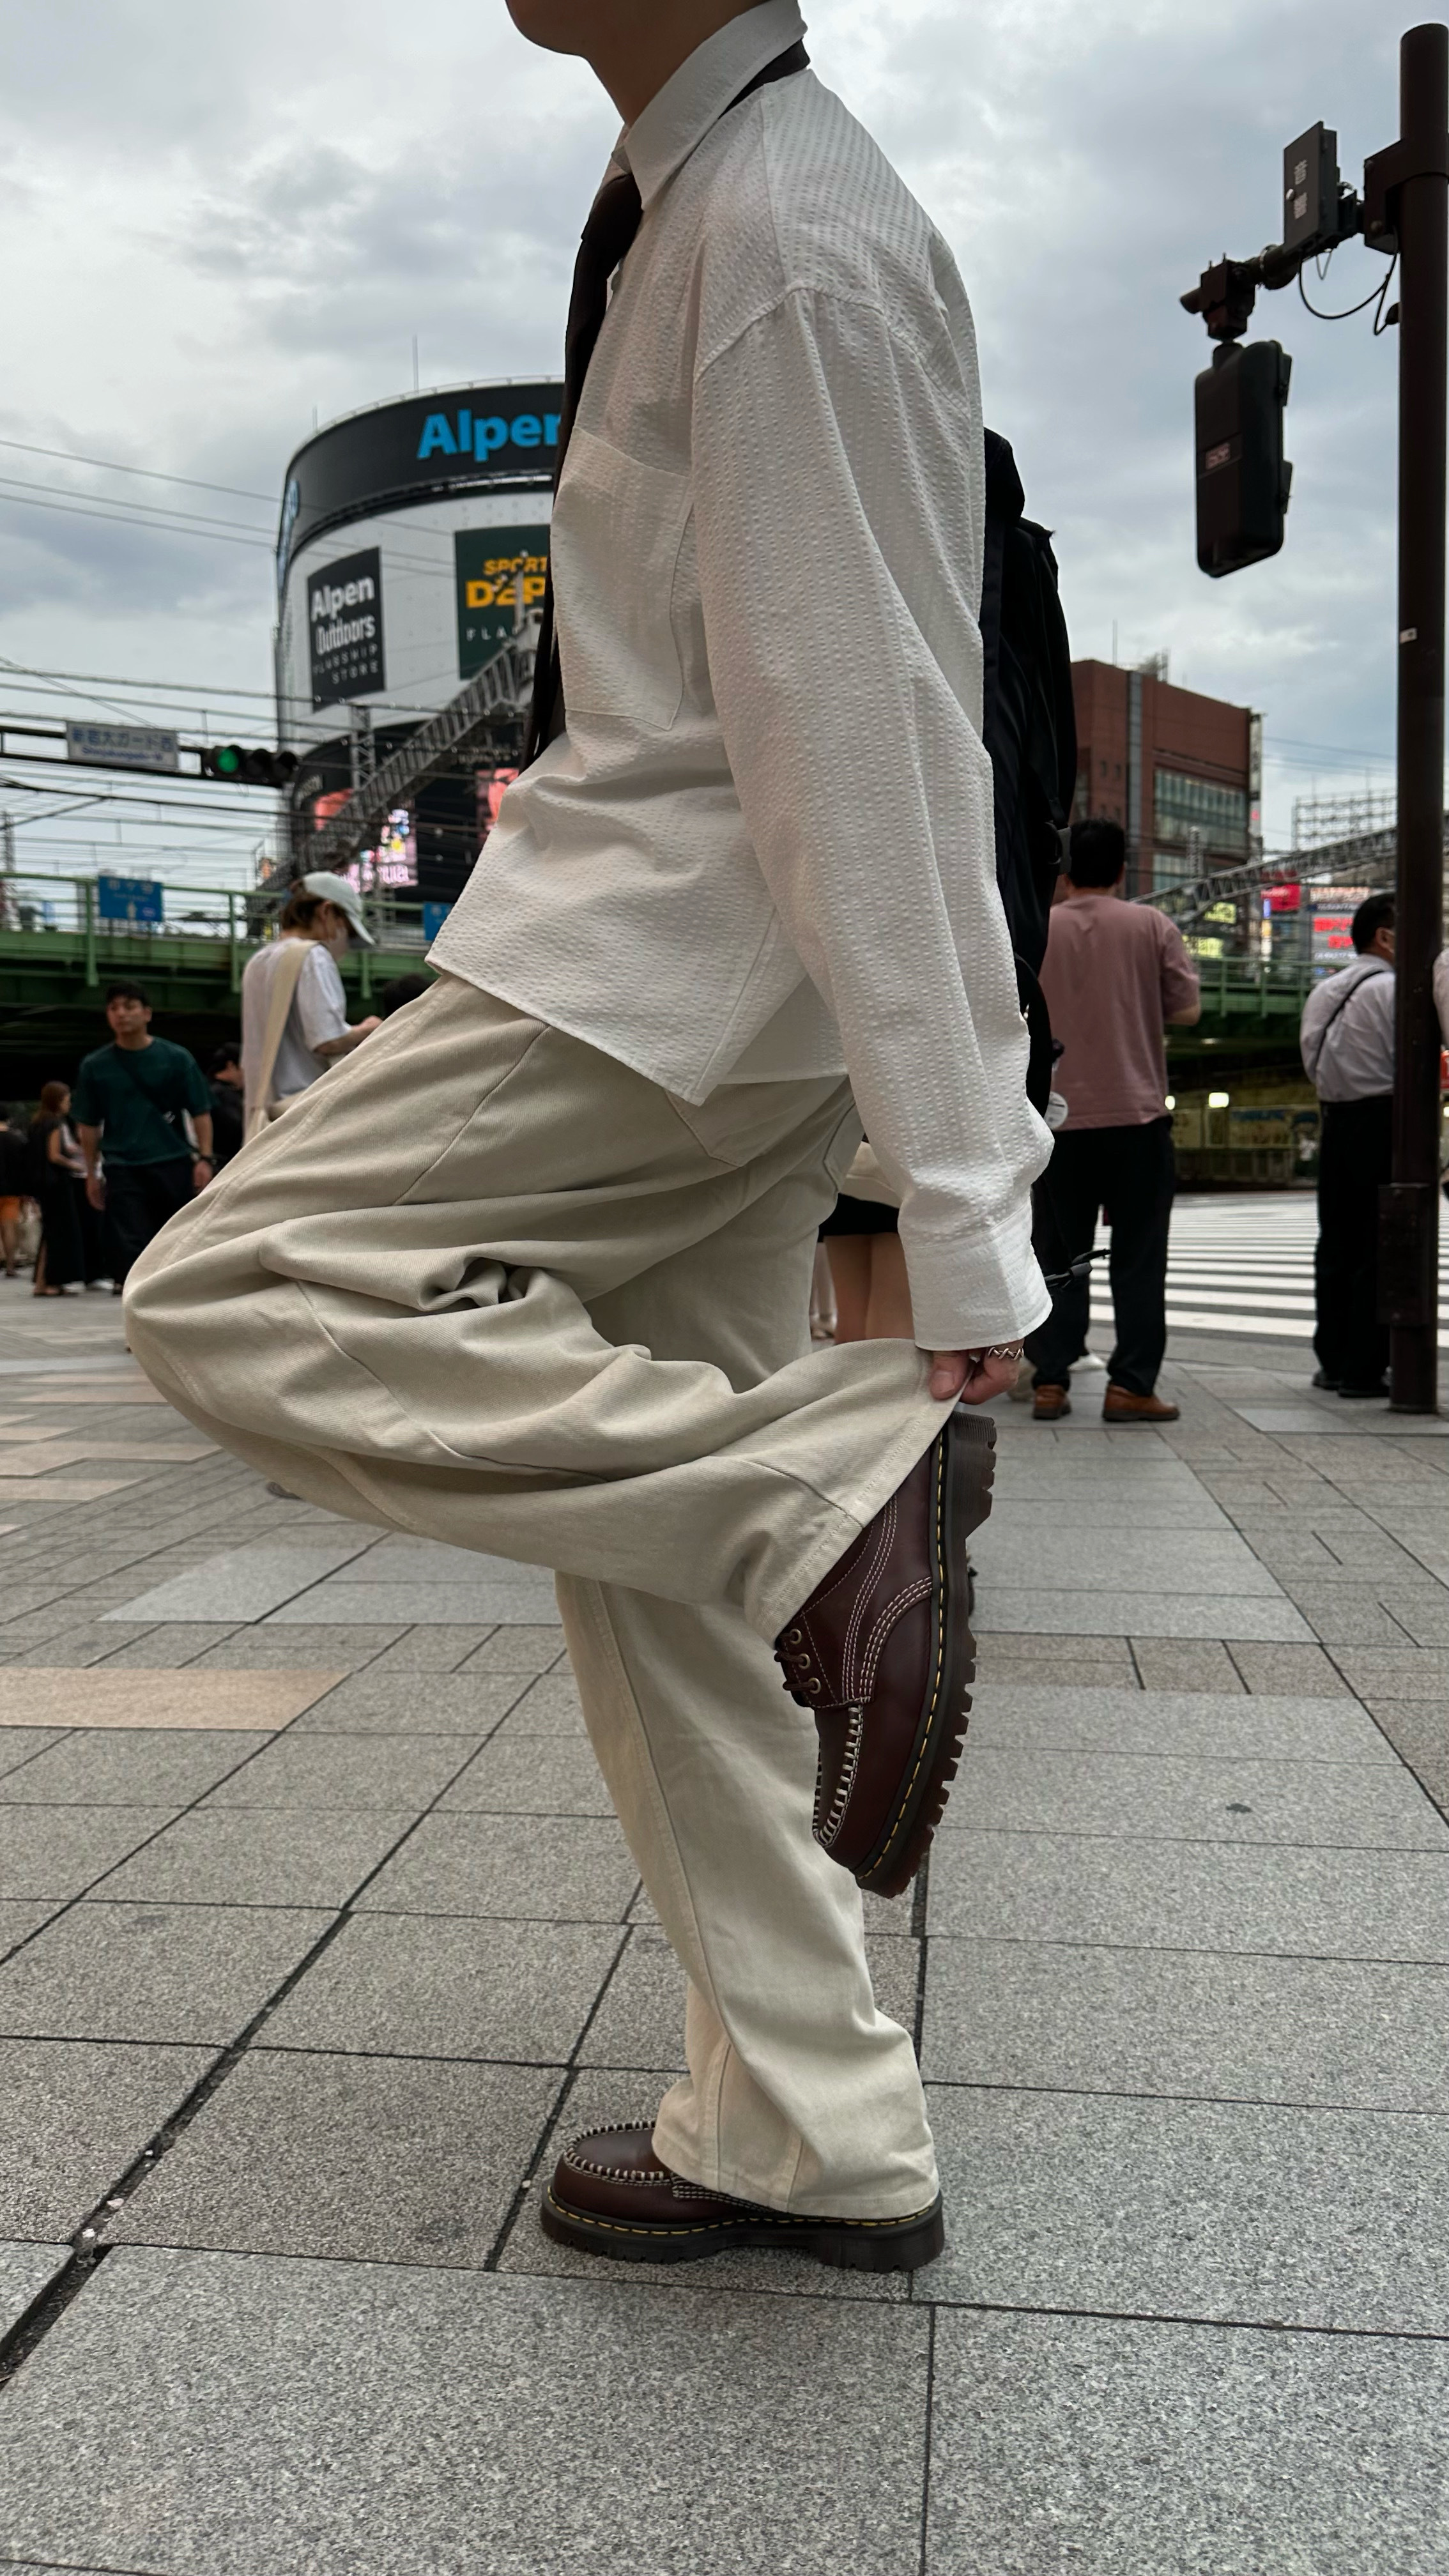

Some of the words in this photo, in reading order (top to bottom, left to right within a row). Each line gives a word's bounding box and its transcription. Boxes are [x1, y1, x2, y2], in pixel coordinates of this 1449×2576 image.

[311, 576, 375, 622] Alpen
[316, 615, 376, 655] Outdoors
[332, 659, 378, 684] STORE
